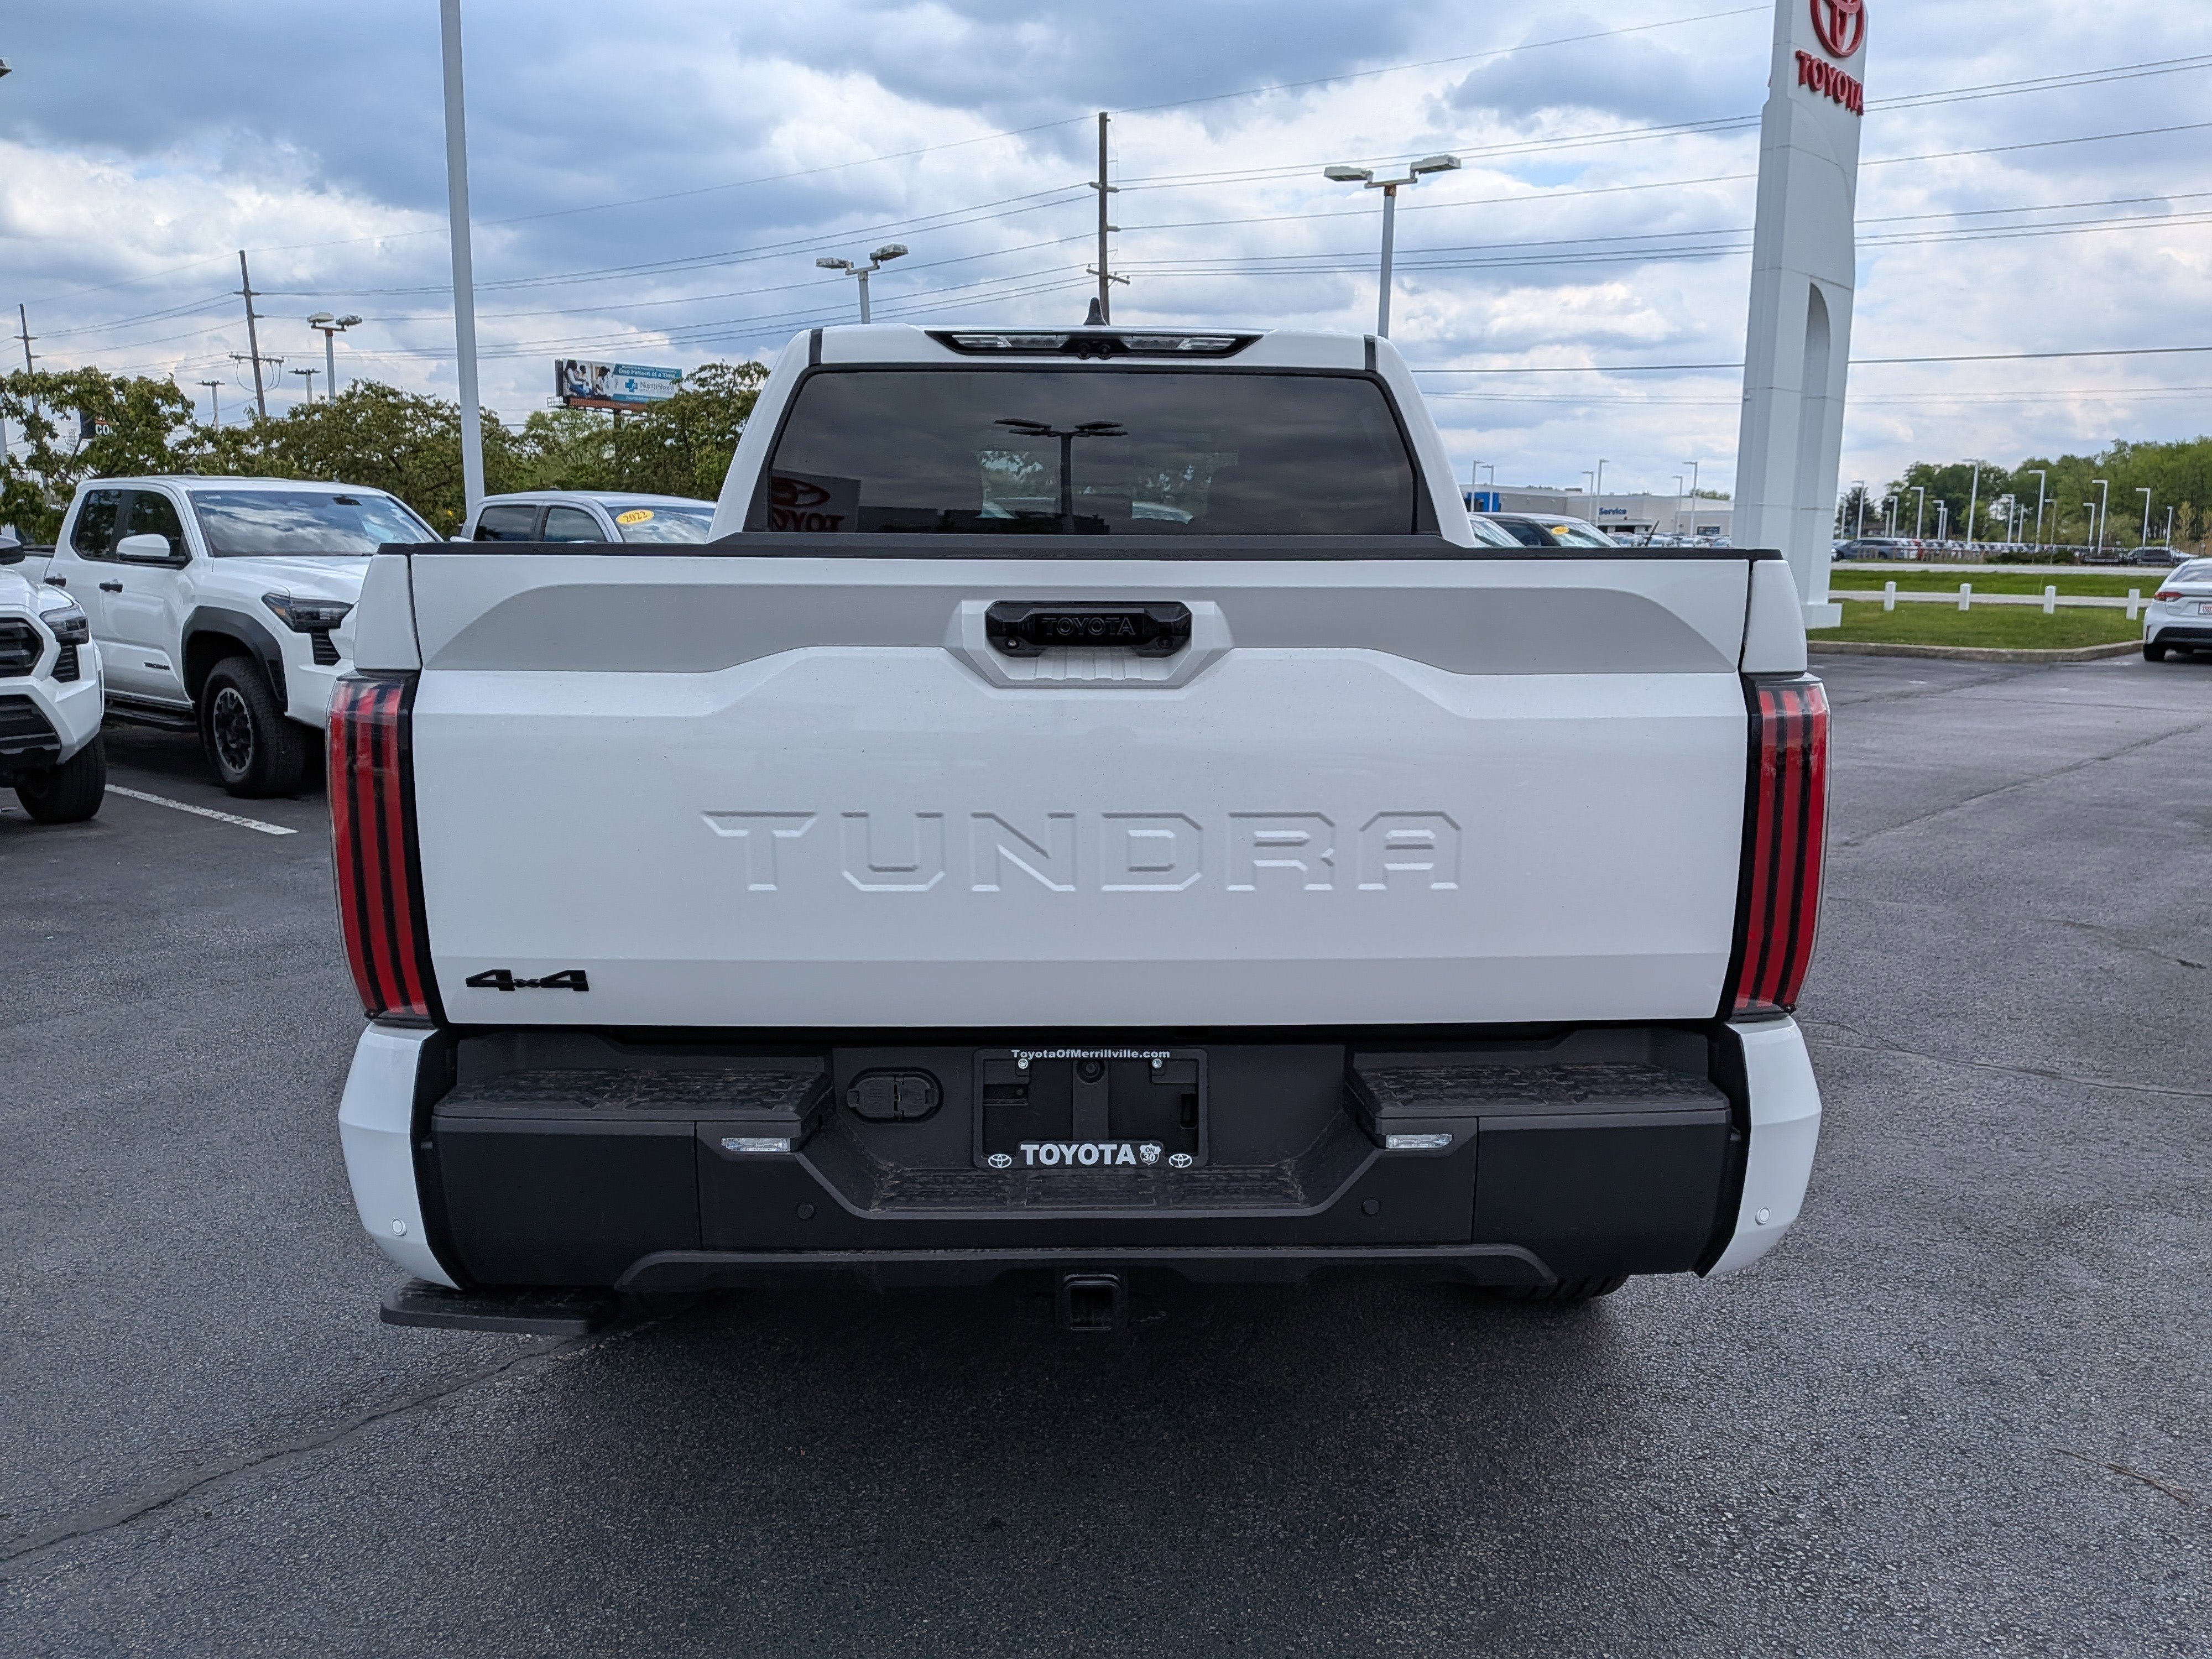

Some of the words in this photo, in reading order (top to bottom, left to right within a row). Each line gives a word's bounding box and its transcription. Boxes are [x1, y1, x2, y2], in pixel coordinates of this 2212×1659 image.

[1795, 50, 1863, 116] TOYOTA
[623, 511, 648, 523] 2022
[1042, 617, 1136, 635] TOYOTA
[702, 811, 1461, 891] TUNDRA
[465, 969, 589, 992] 4x4
[1011, 1048, 1170, 1060] ToyotaOfMerrillville.com
[1020, 1143, 1137, 1165] TOYOTA
[1142, 1153, 1156, 1162] 30
